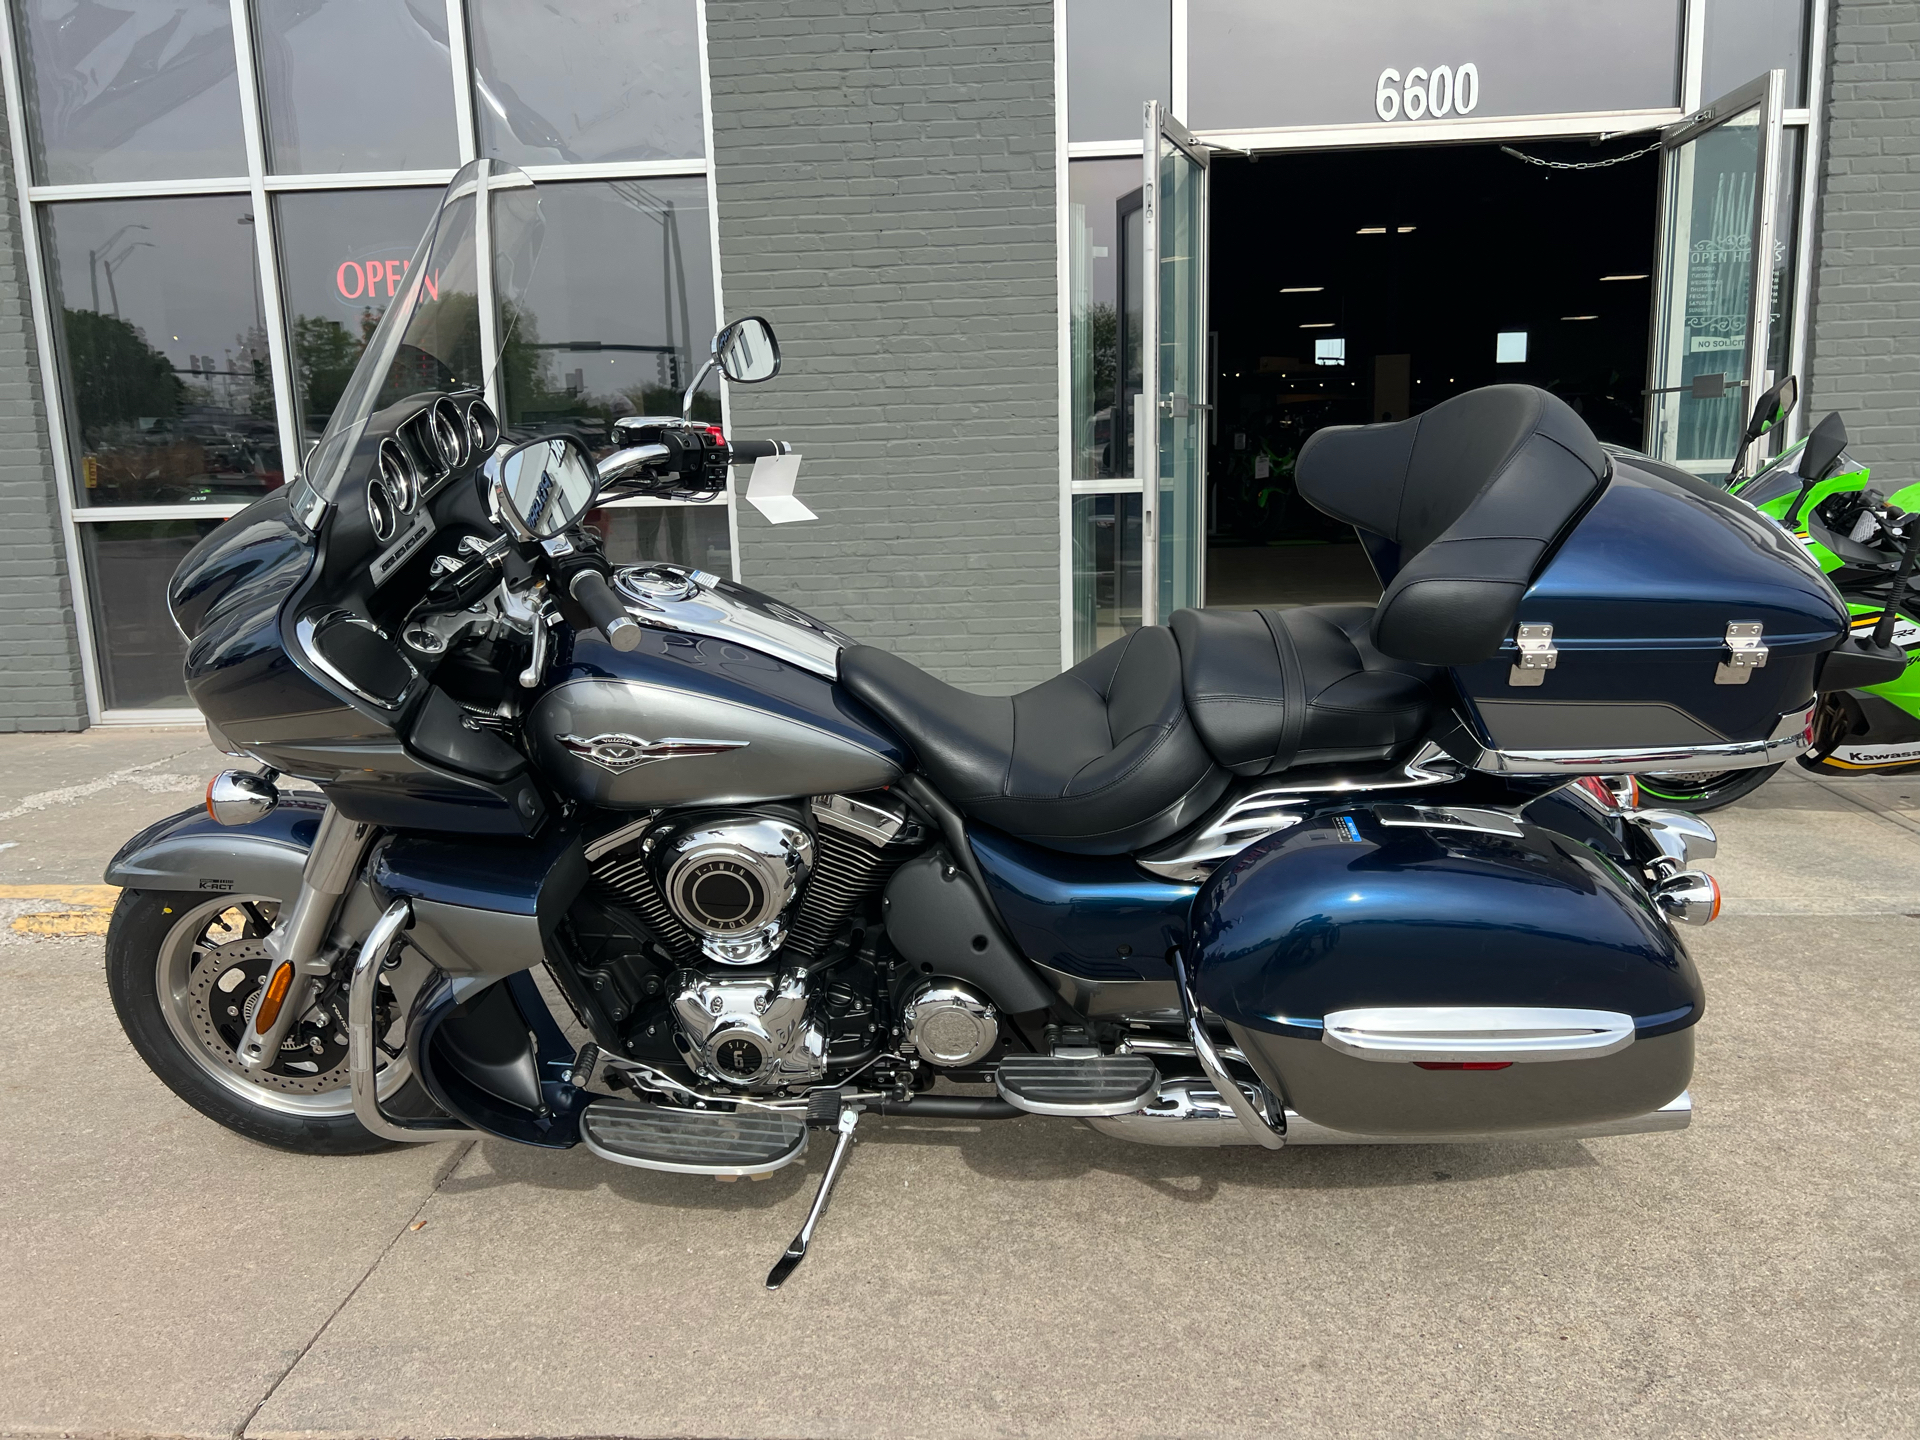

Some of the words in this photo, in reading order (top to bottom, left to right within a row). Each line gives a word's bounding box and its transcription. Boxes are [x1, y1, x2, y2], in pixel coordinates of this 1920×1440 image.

[1375, 62, 1479, 122] 6600
[1691, 252, 1727, 264] OPEN
[1733, 250, 1782, 264] HOS
[336, 259, 439, 303] OPEN
[1698, 340, 1710, 348] NO
[601, 737, 633, 745] Vulcan
[695, 862, 746, 876] V-TWIN
[199, 882, 234, 890] K-ACT
[705, 918, 747, 929] 1700
[728, 1041, 748, 1050] SIX
[733, 1050, 744, 1069] 6
